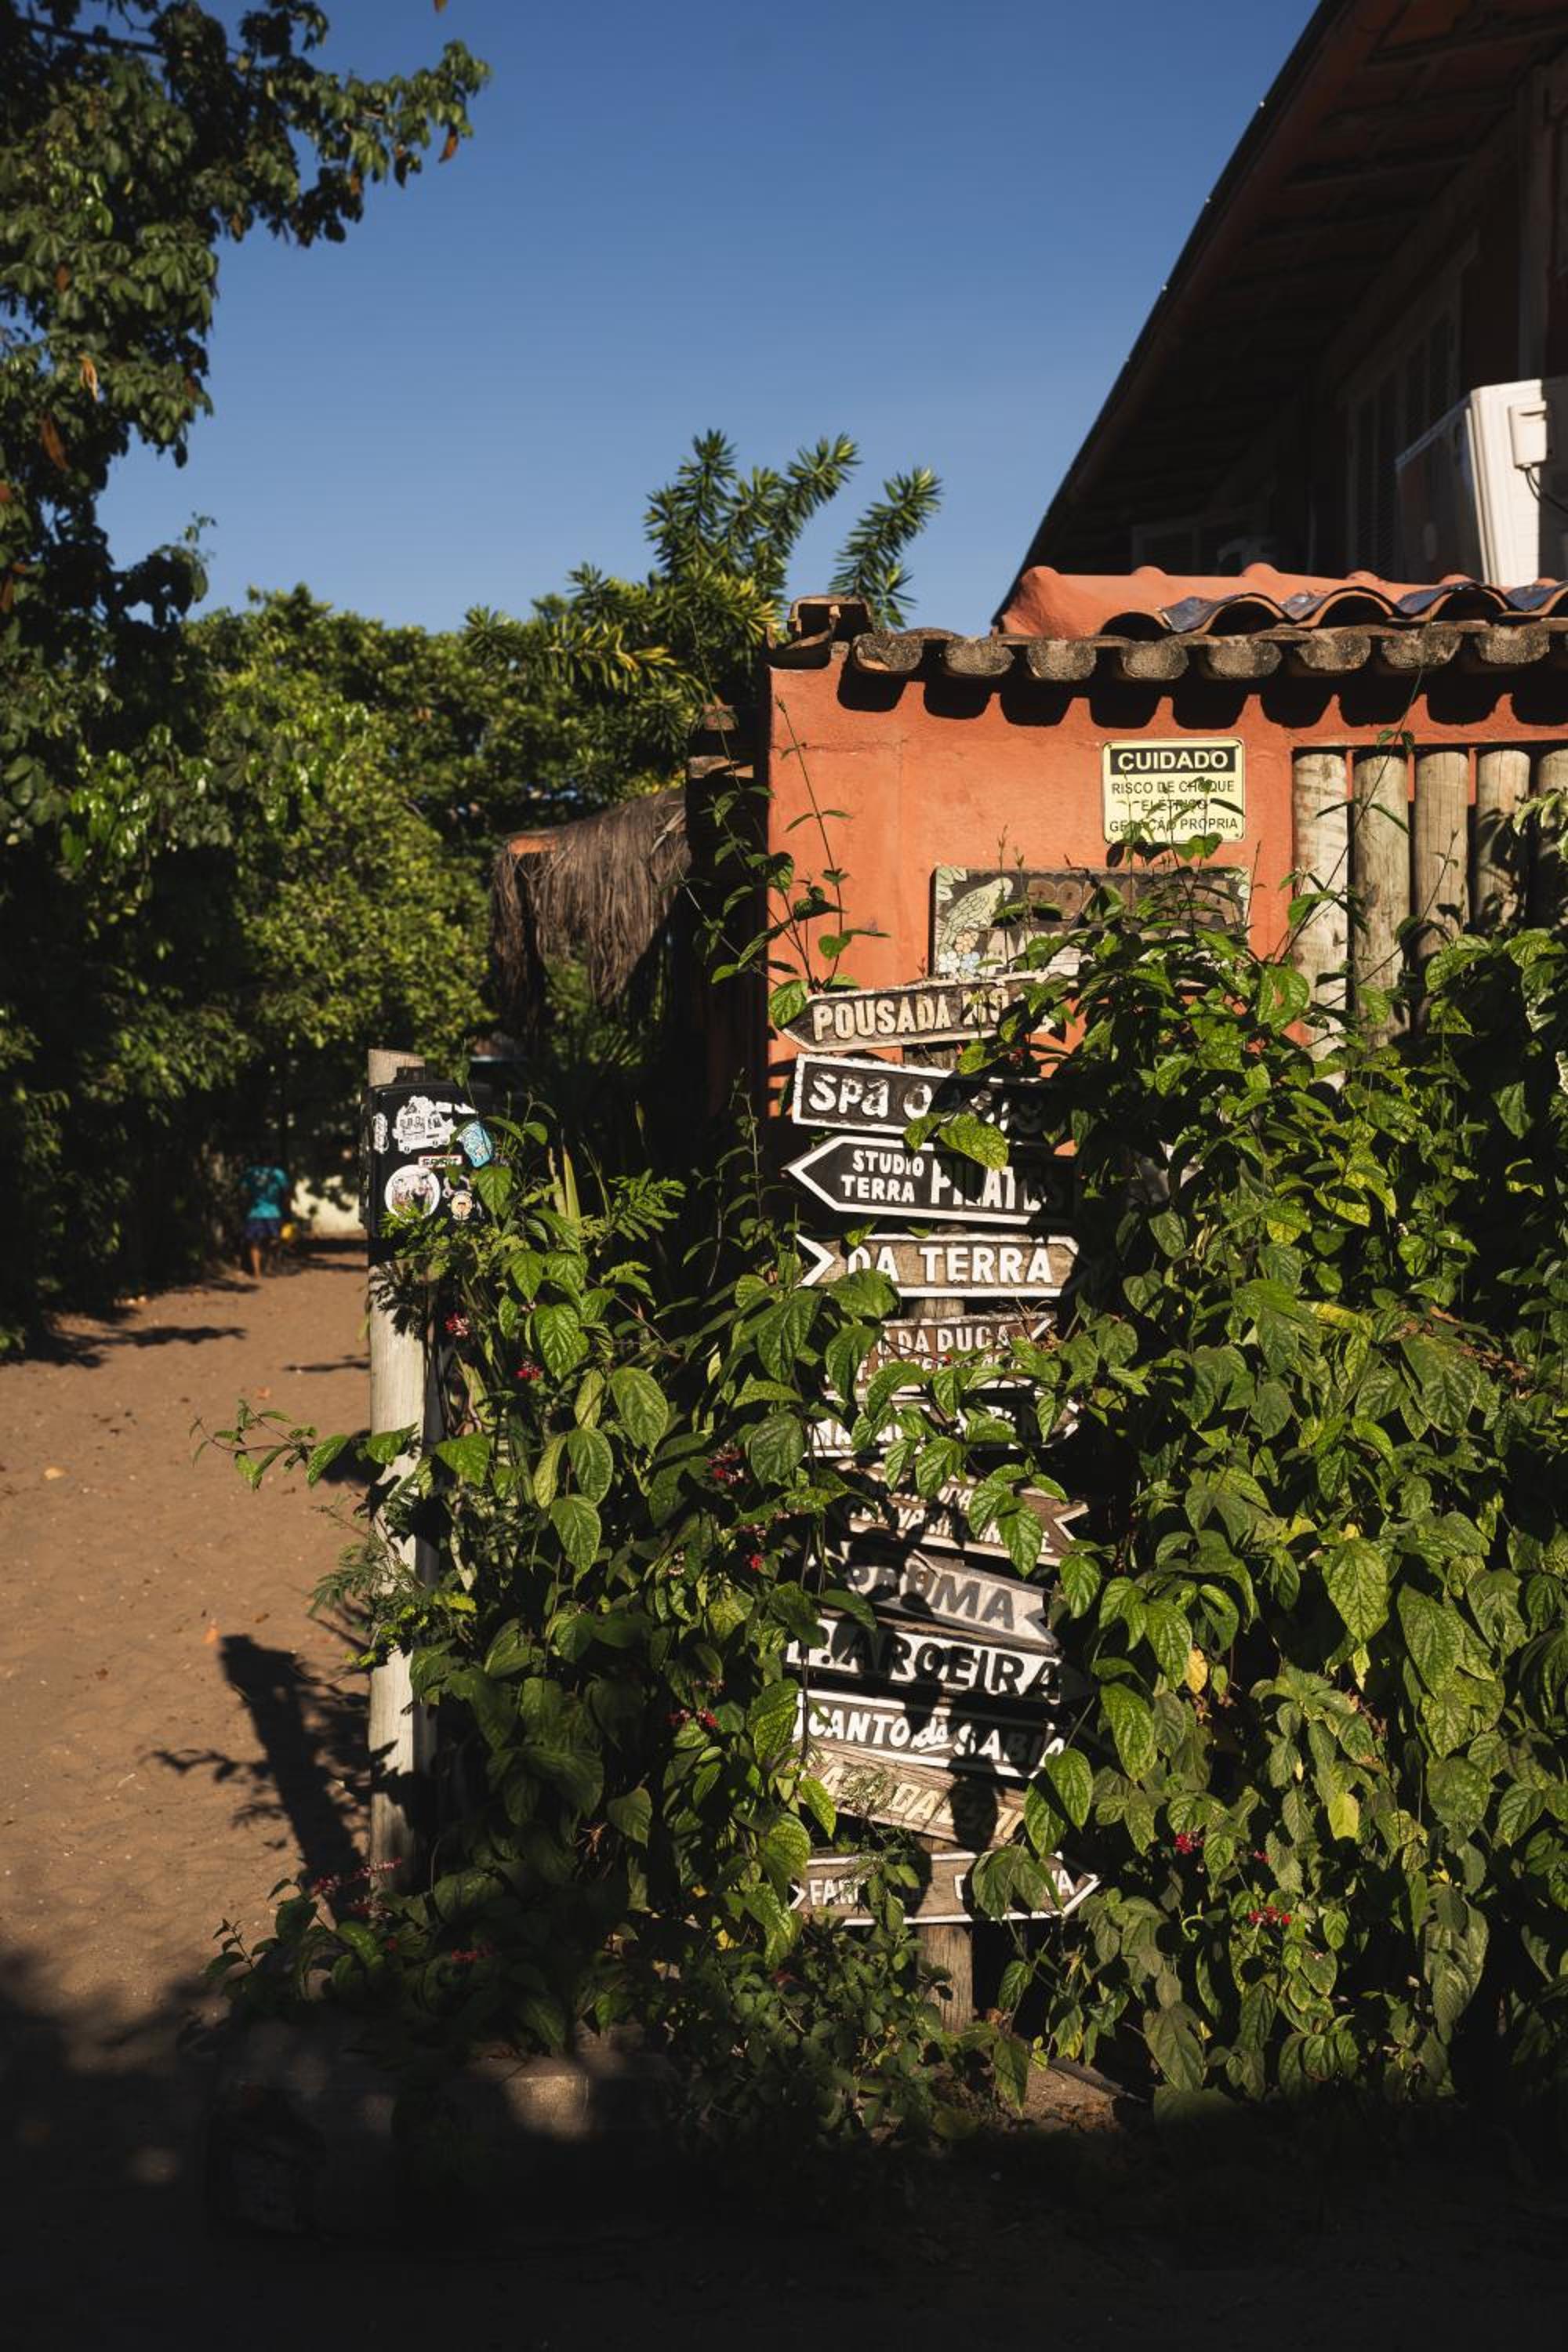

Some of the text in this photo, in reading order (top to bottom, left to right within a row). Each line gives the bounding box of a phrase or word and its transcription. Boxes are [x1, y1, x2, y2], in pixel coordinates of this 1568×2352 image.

[1118, 750, 1229, 771] CUIDADO
[1112, 781, 1153, 795] RISCO
[1156, 781, 1174, 794] DE
[812, 993, 953, 1042] POUSADA
[852, 1149, 925, 1178] STUDIO
[841, 1174, 916, 1203] TERRA
[919, 1246, 1054, 1285] TERRA
[898, 1328, 931, 1356] DA
[808, 1705, 911, 1748] CANTO
